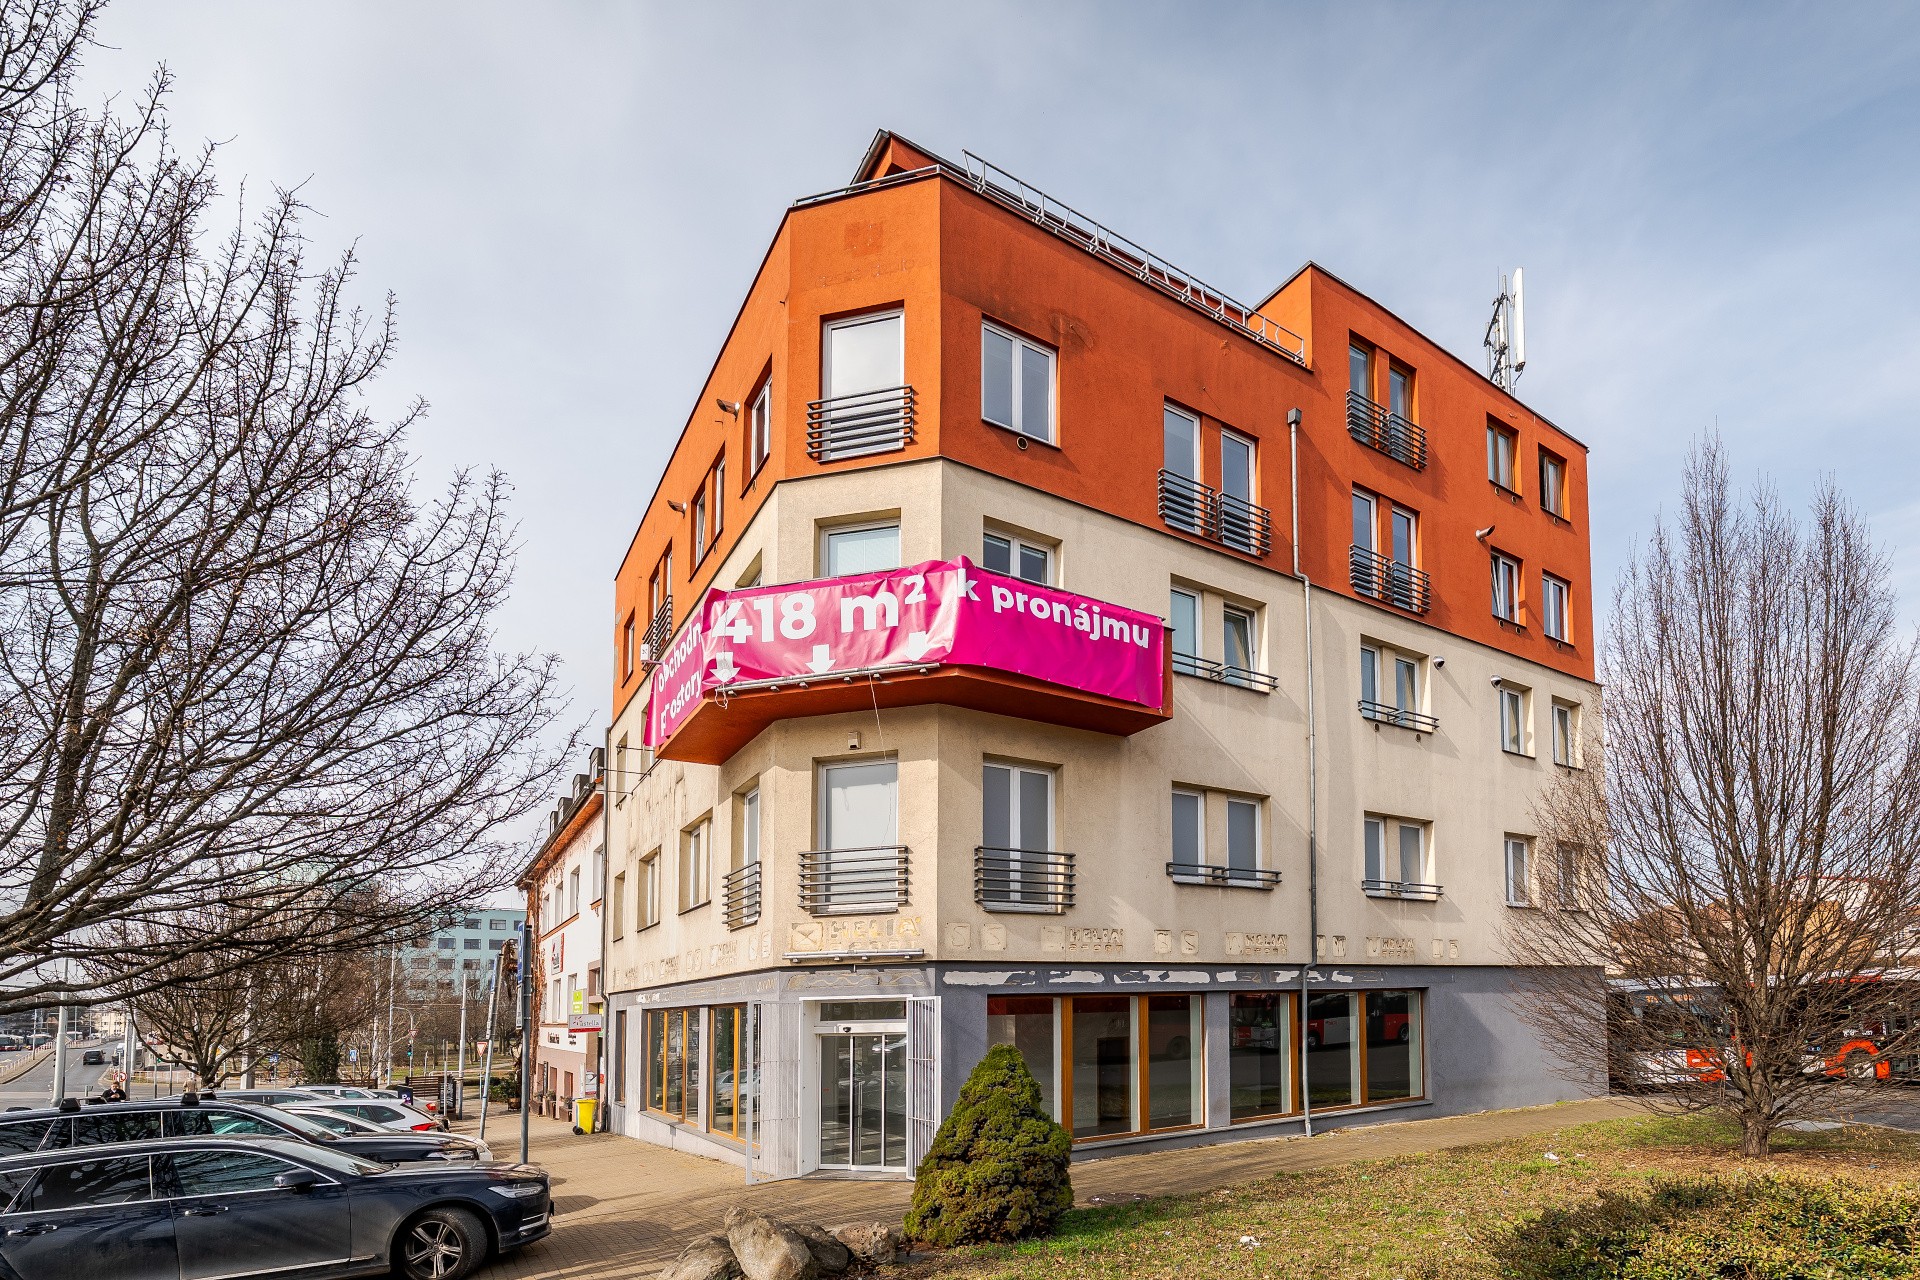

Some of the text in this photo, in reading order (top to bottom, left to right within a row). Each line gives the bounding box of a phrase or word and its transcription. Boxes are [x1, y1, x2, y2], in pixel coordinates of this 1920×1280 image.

[711, 593, 817, 644] 418
[957, 567, 982, 602] k
[991, 584, 1150, 649] pronájmu
